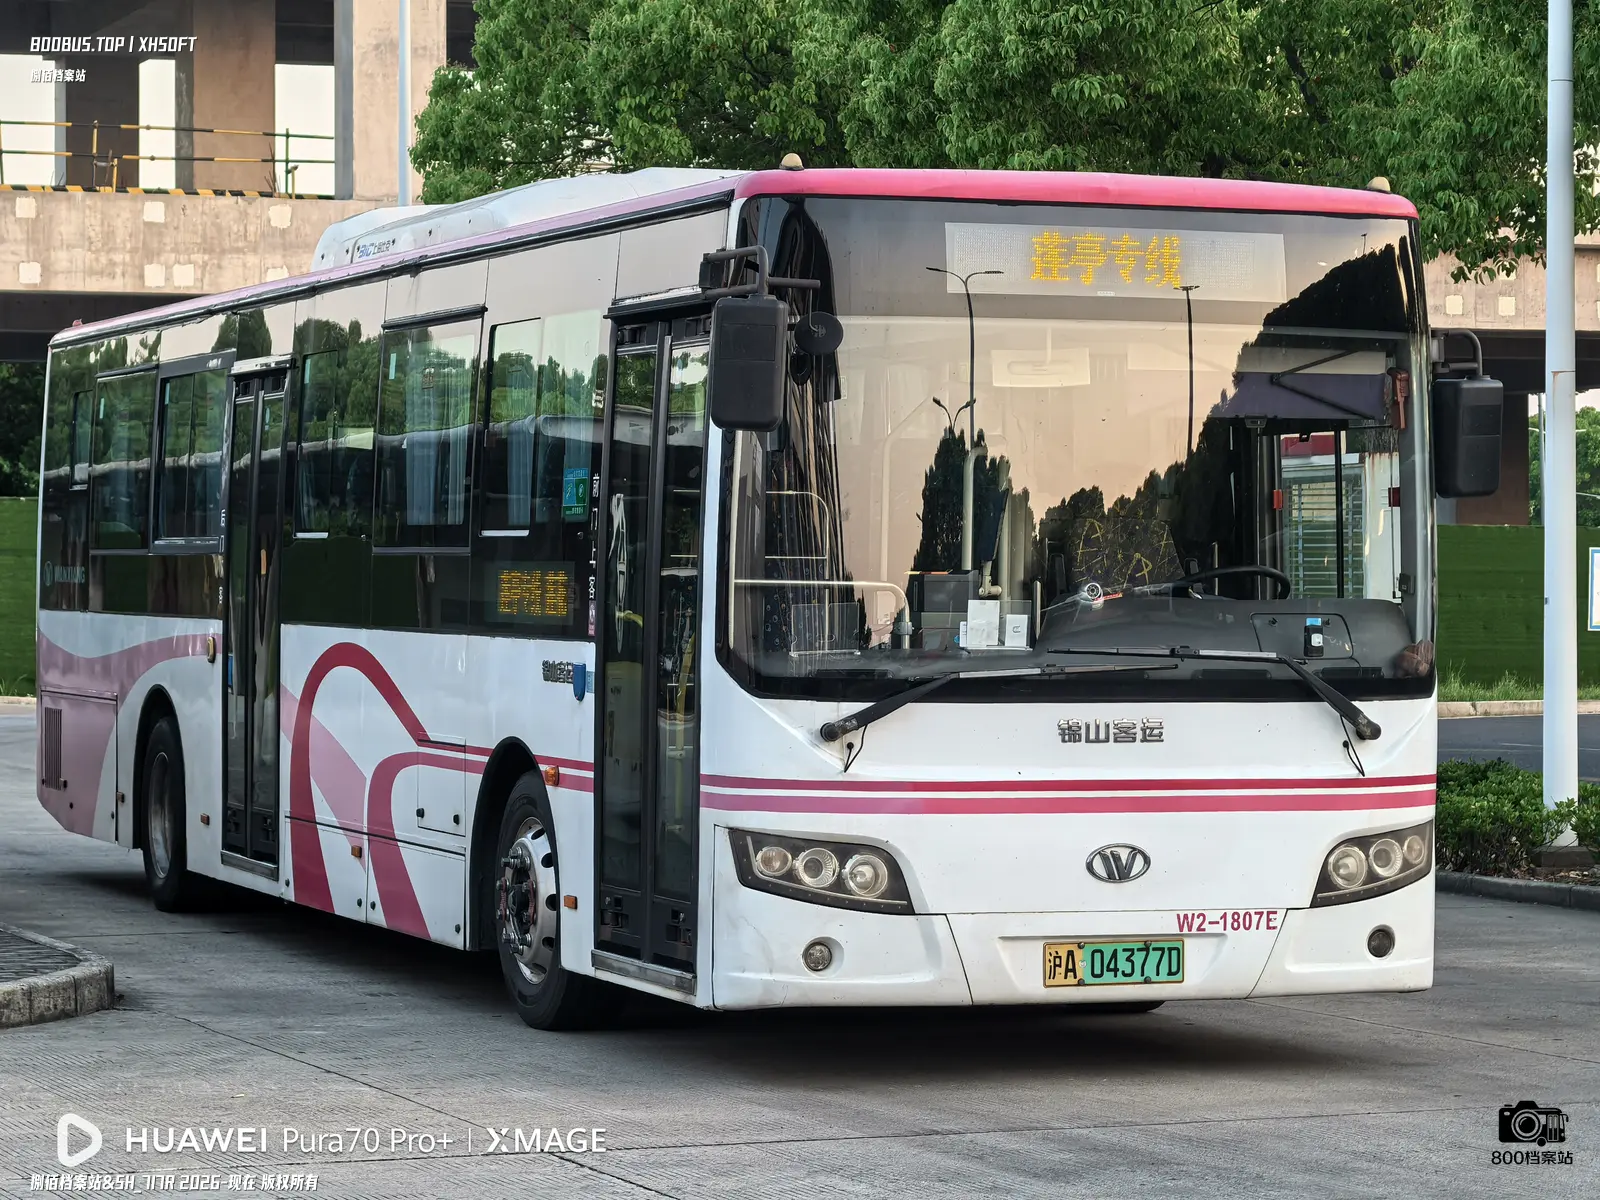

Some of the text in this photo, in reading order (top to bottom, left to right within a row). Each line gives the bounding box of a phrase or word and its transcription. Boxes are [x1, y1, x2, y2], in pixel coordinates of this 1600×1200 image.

[1030, 231, 1181, 288] 莲亭专线
[1057, 717, 1165, 744] 锦山客运
[1176, 910, 1278, 933] W2-1807E
